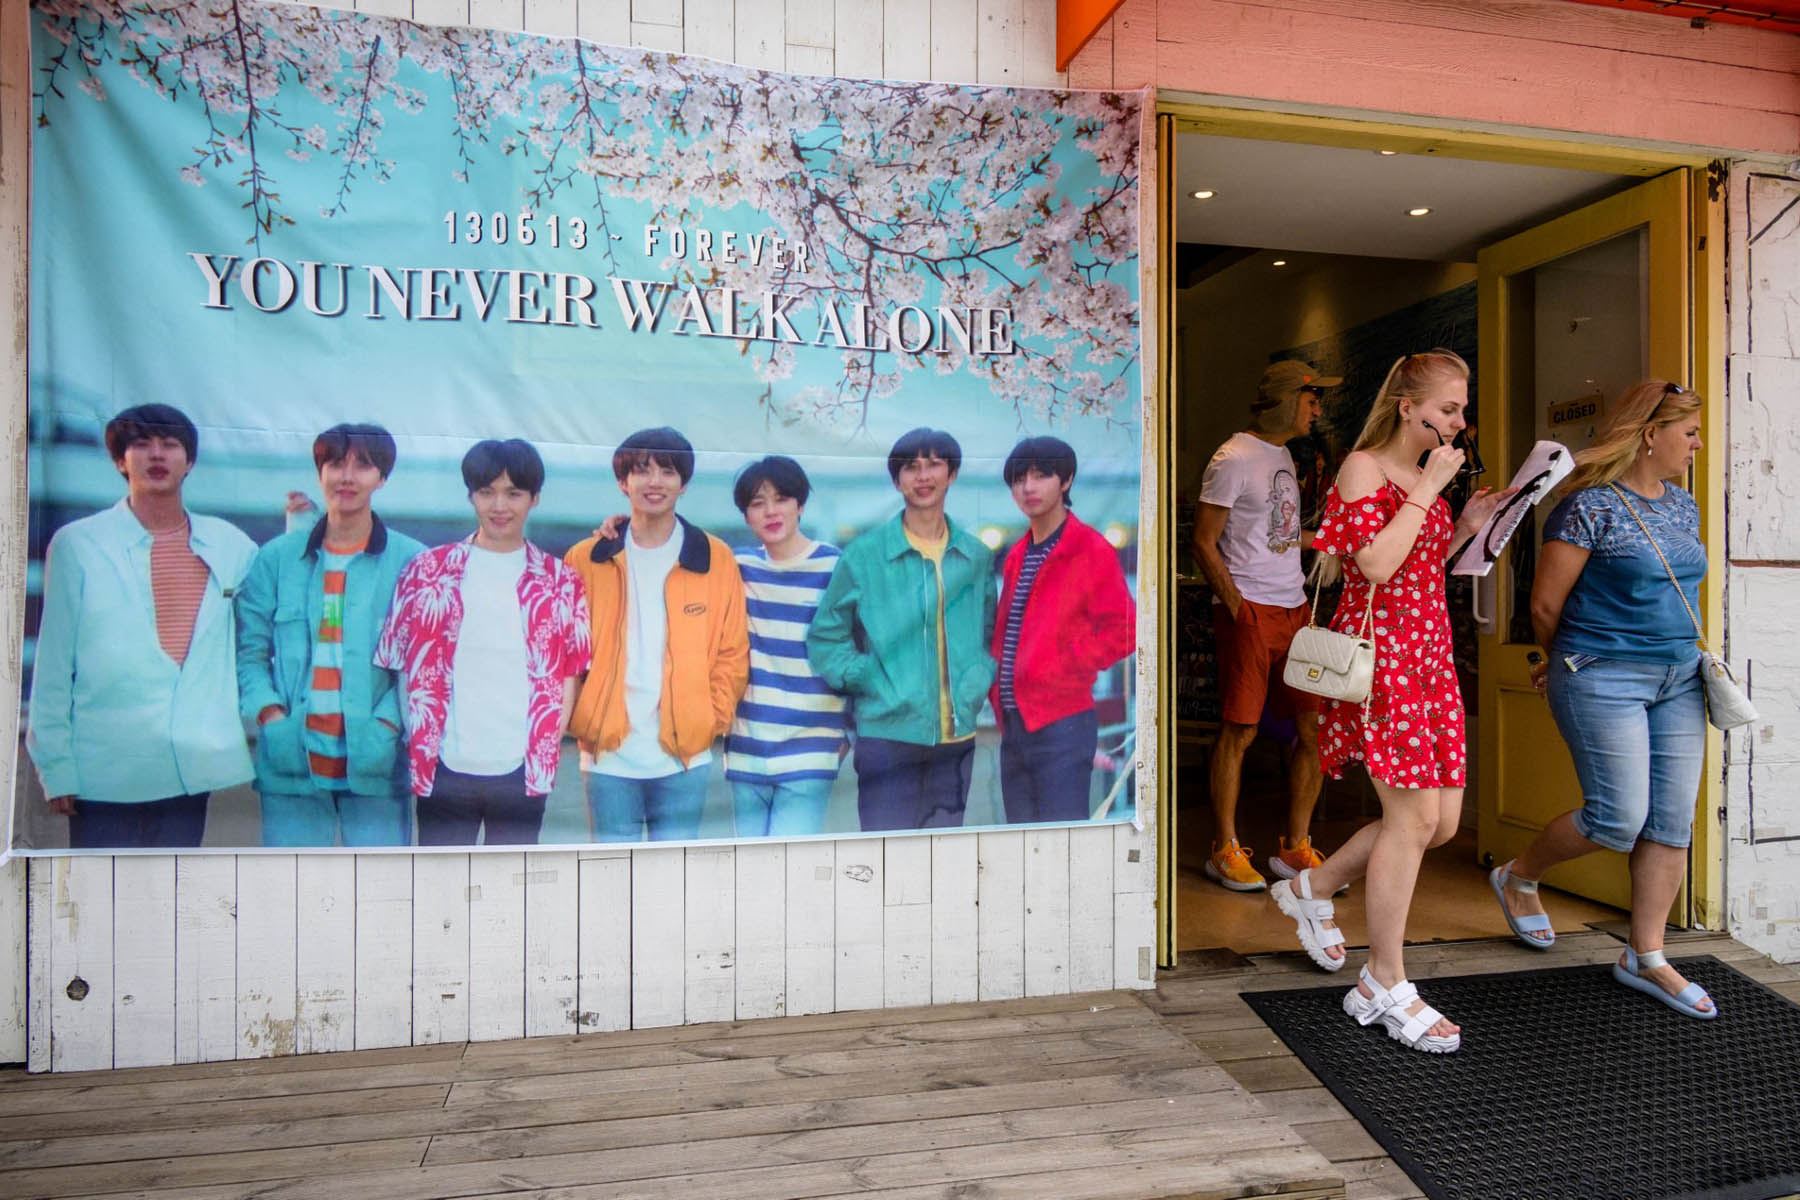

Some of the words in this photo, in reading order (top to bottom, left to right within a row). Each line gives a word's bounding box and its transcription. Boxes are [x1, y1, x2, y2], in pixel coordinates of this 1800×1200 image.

[444, 211, 587, 249] 130613
[643, 224, 810, 273] FOREVER
[188, 252, 352, 317] YOU
[363, 265, 600, 327] NEVER
[606, 276, 808, 345] WALK
[814, 299, 1018, 354] ALONE
[1553, 403, 1596, 423] CLOSED
